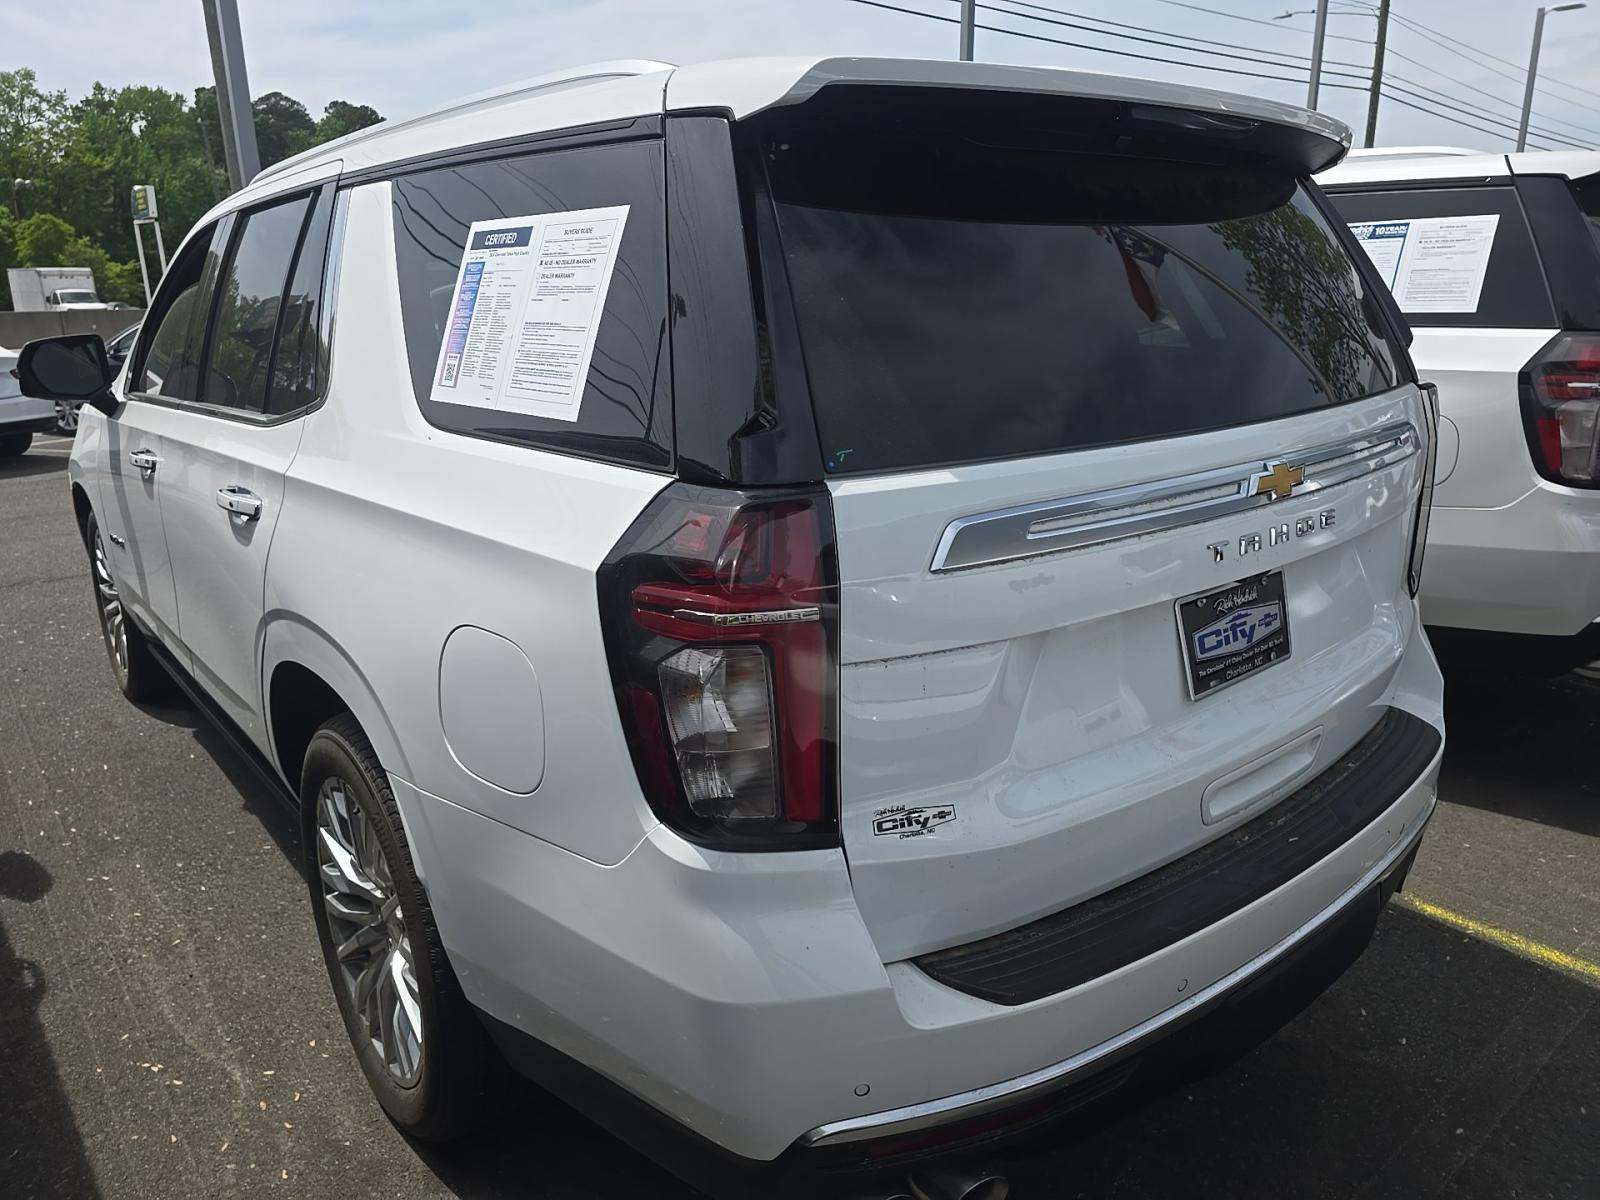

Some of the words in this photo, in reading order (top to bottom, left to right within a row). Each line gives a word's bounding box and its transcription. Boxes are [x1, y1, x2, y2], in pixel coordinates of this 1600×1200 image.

[563, 228, 580, 236] BUYERS
[580, 227, 593, 235] GUIDE
[1375, 226, 1386, 235] 10
[484, 232, 517, 246] CERTIFIED
[1206, 507, 1336, 564] TAHOE
[1197, 620, 1256, 654] City
[876, 815, 930, 832] City
